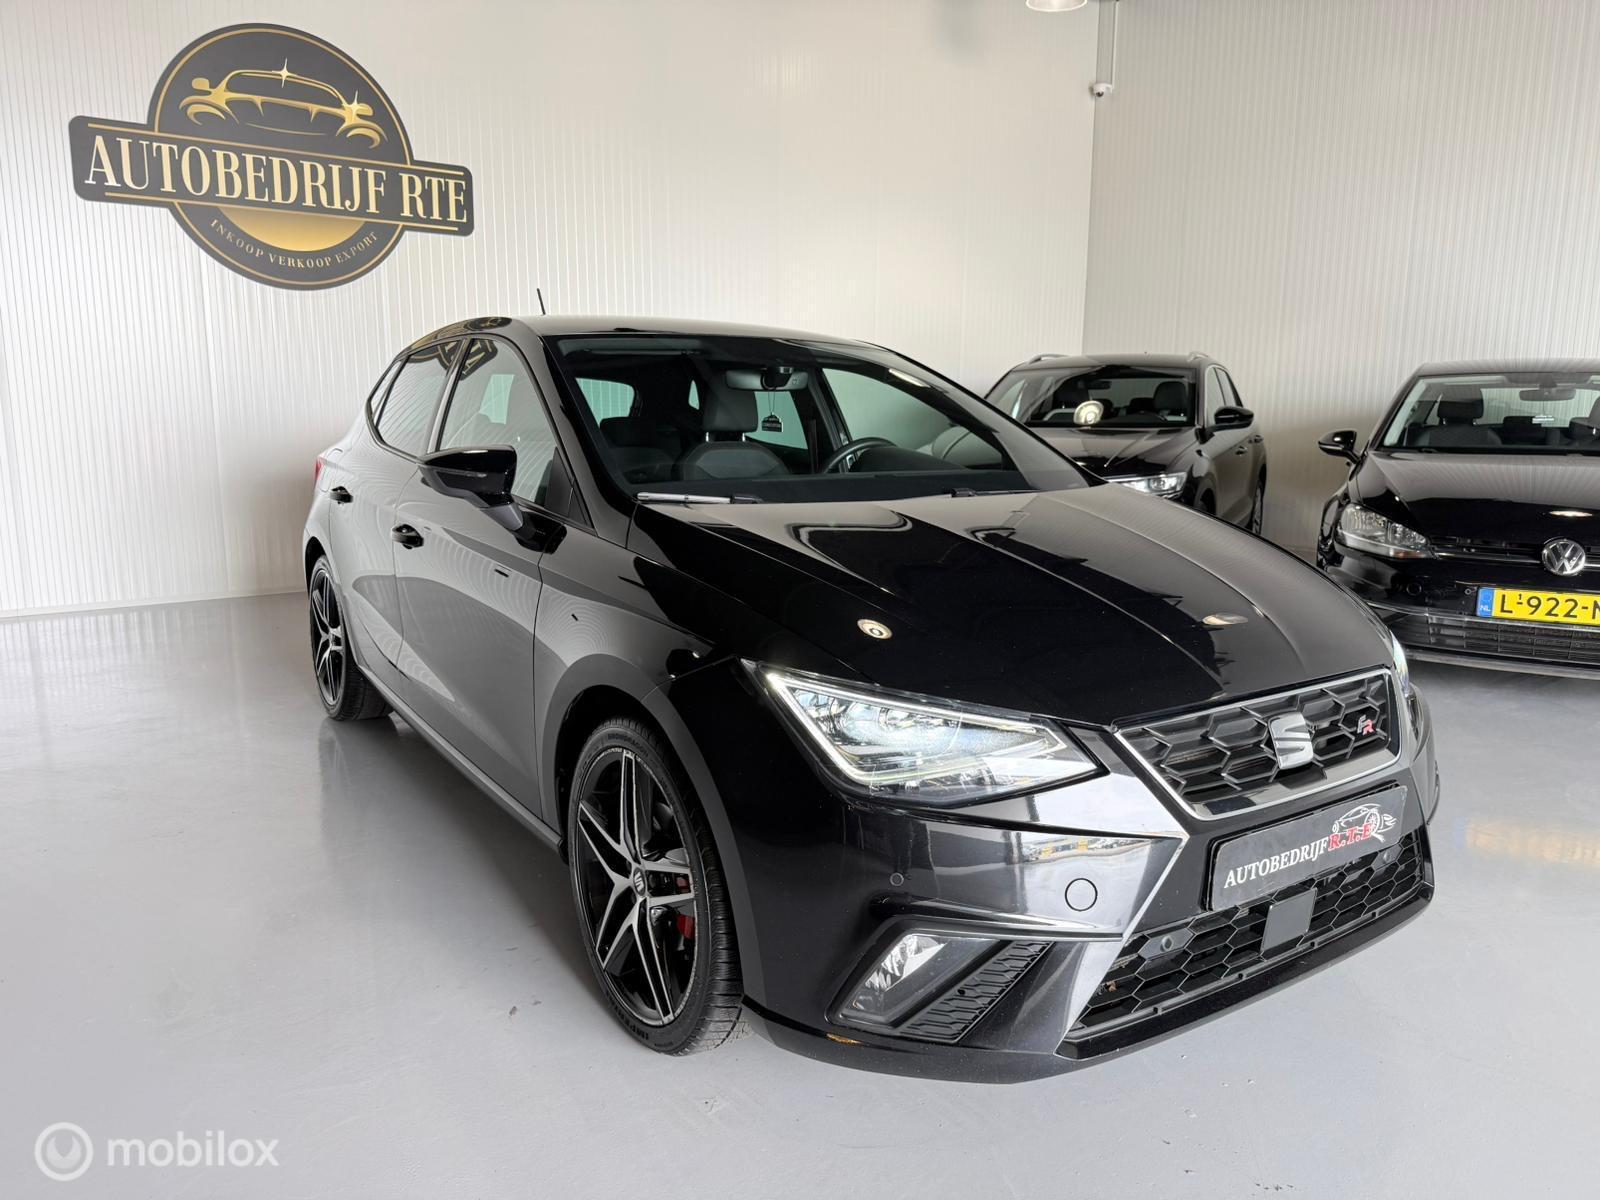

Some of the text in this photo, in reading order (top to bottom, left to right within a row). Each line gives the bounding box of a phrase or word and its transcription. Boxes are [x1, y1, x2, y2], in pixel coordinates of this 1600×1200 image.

[84, 135, 468, 223] AUTOBEDRIJF RTE
[210, 218, 379, 269] INKOOP VERKOOP EXPORT
[1480, 604, 1491, 612] NL
[1356, 714, 1376, 736] FR
[1224, 836, 1329, 888] AUTOBEDRIJF
